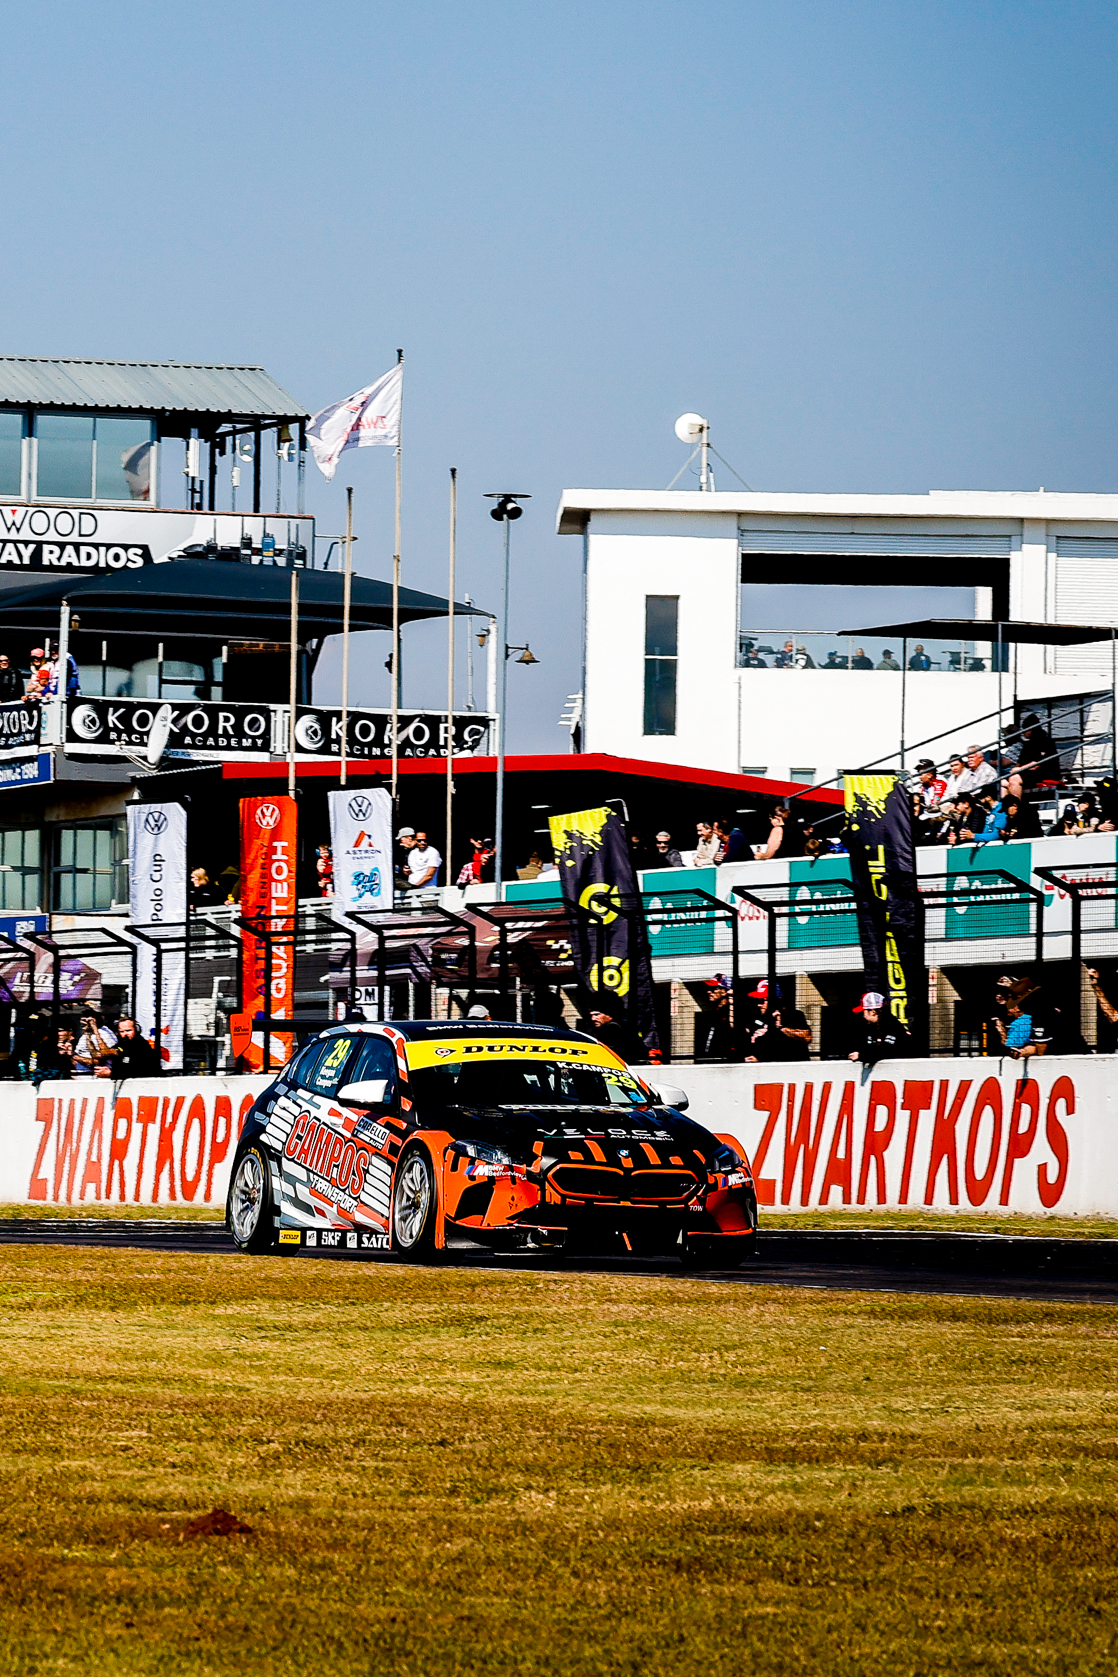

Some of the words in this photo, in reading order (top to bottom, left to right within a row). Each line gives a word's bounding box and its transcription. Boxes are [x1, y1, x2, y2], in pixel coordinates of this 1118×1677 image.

[41, 543, 144, 570] RADIOS
[108, 708, 266, 736] KOKORO
[110, 732, 149, 743] RACI
[184, 736, 263, 747] ACADEMY
[149, 853, 165, 881] Cup
[149, 887, 163, 922] Polo
[324, 1039, 351, 1067] 29
[462, 1044, 588, 1058] DUNLOP
[556, 1062, 632, 1079] K.CAMPOS
[602, 1073, 637, 1089] 29
[537, 1128, 671, 1138] VELOCE
[753, 1075, 1075, 1208] ZWARTKOPS
[285, 1111, 369, 1197] CAMPOS
[488, 1171, 522, 1179] Bedfordview
[310, 1172, 359, 1213] TRANSPORT
[321, 1232, 341, 1246] SKF
